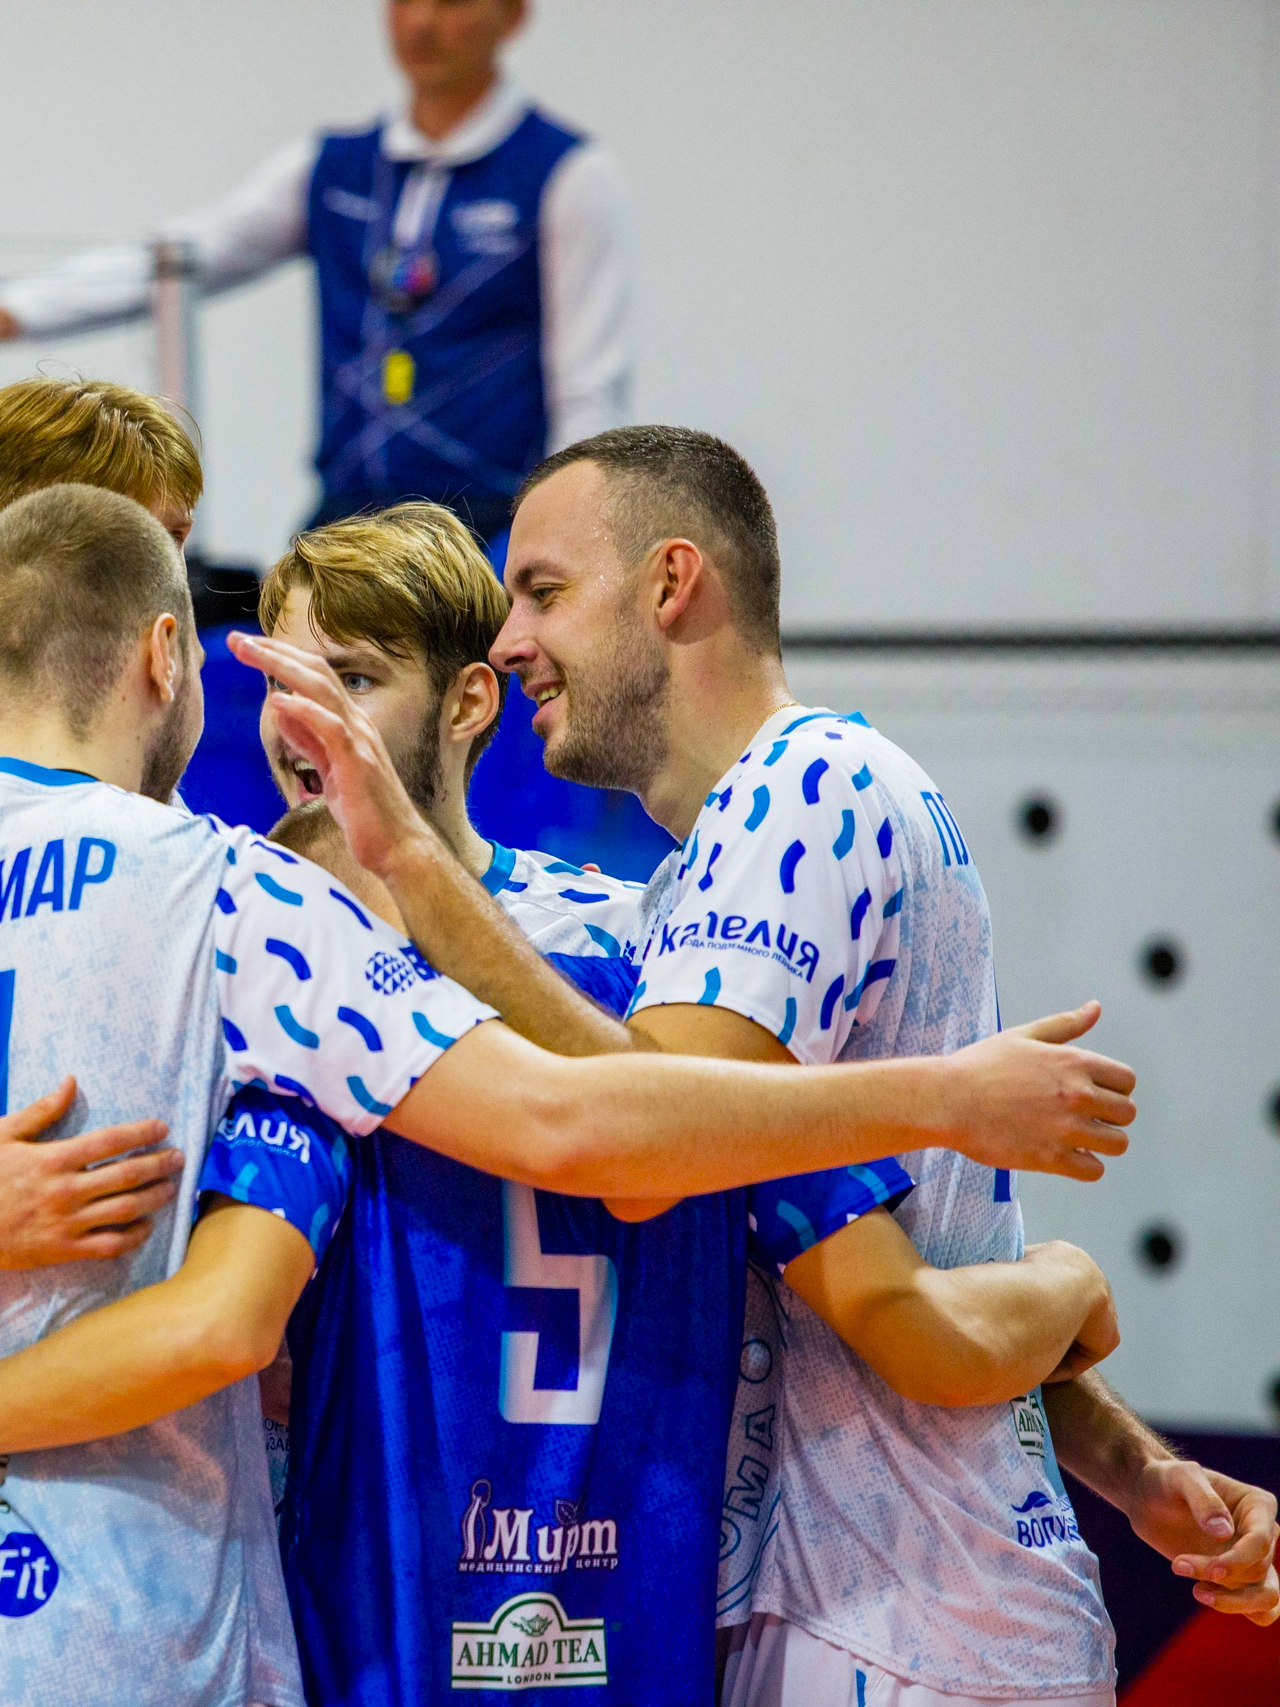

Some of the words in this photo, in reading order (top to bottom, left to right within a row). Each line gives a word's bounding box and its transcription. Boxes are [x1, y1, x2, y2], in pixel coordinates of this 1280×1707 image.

[684, 938, 705, 949] ОДА
[499, 1176, 618, 1425] 5
[575, 1556, 619, 1569] центр
[456, 1640, 550, 1668] AHMAD
[553, 1637, 602, 1665] TEA
[507, 1672, 552, 1684] LONDON
